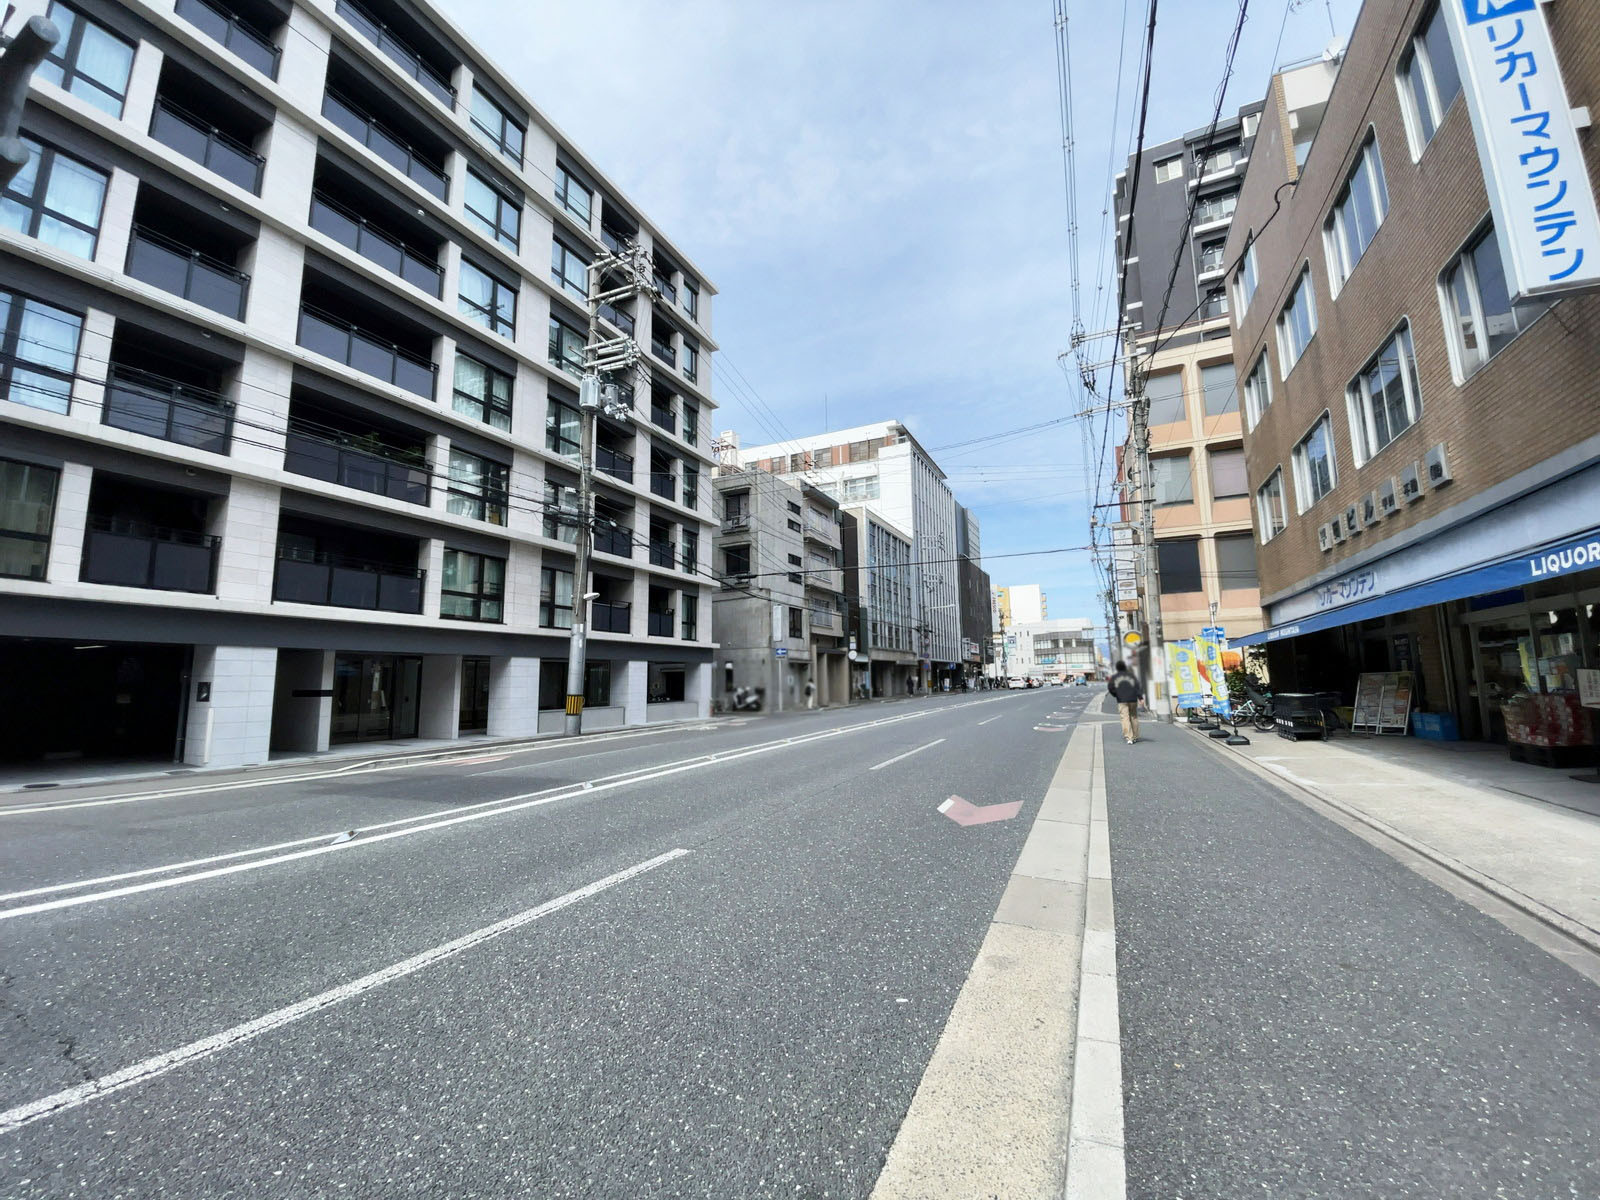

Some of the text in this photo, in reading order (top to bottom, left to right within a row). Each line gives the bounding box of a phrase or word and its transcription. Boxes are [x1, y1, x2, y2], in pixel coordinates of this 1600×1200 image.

[1485, 18, 1585, 282] リカーマウンテン
[1530, 541, 1600, 577] LIQUOR
